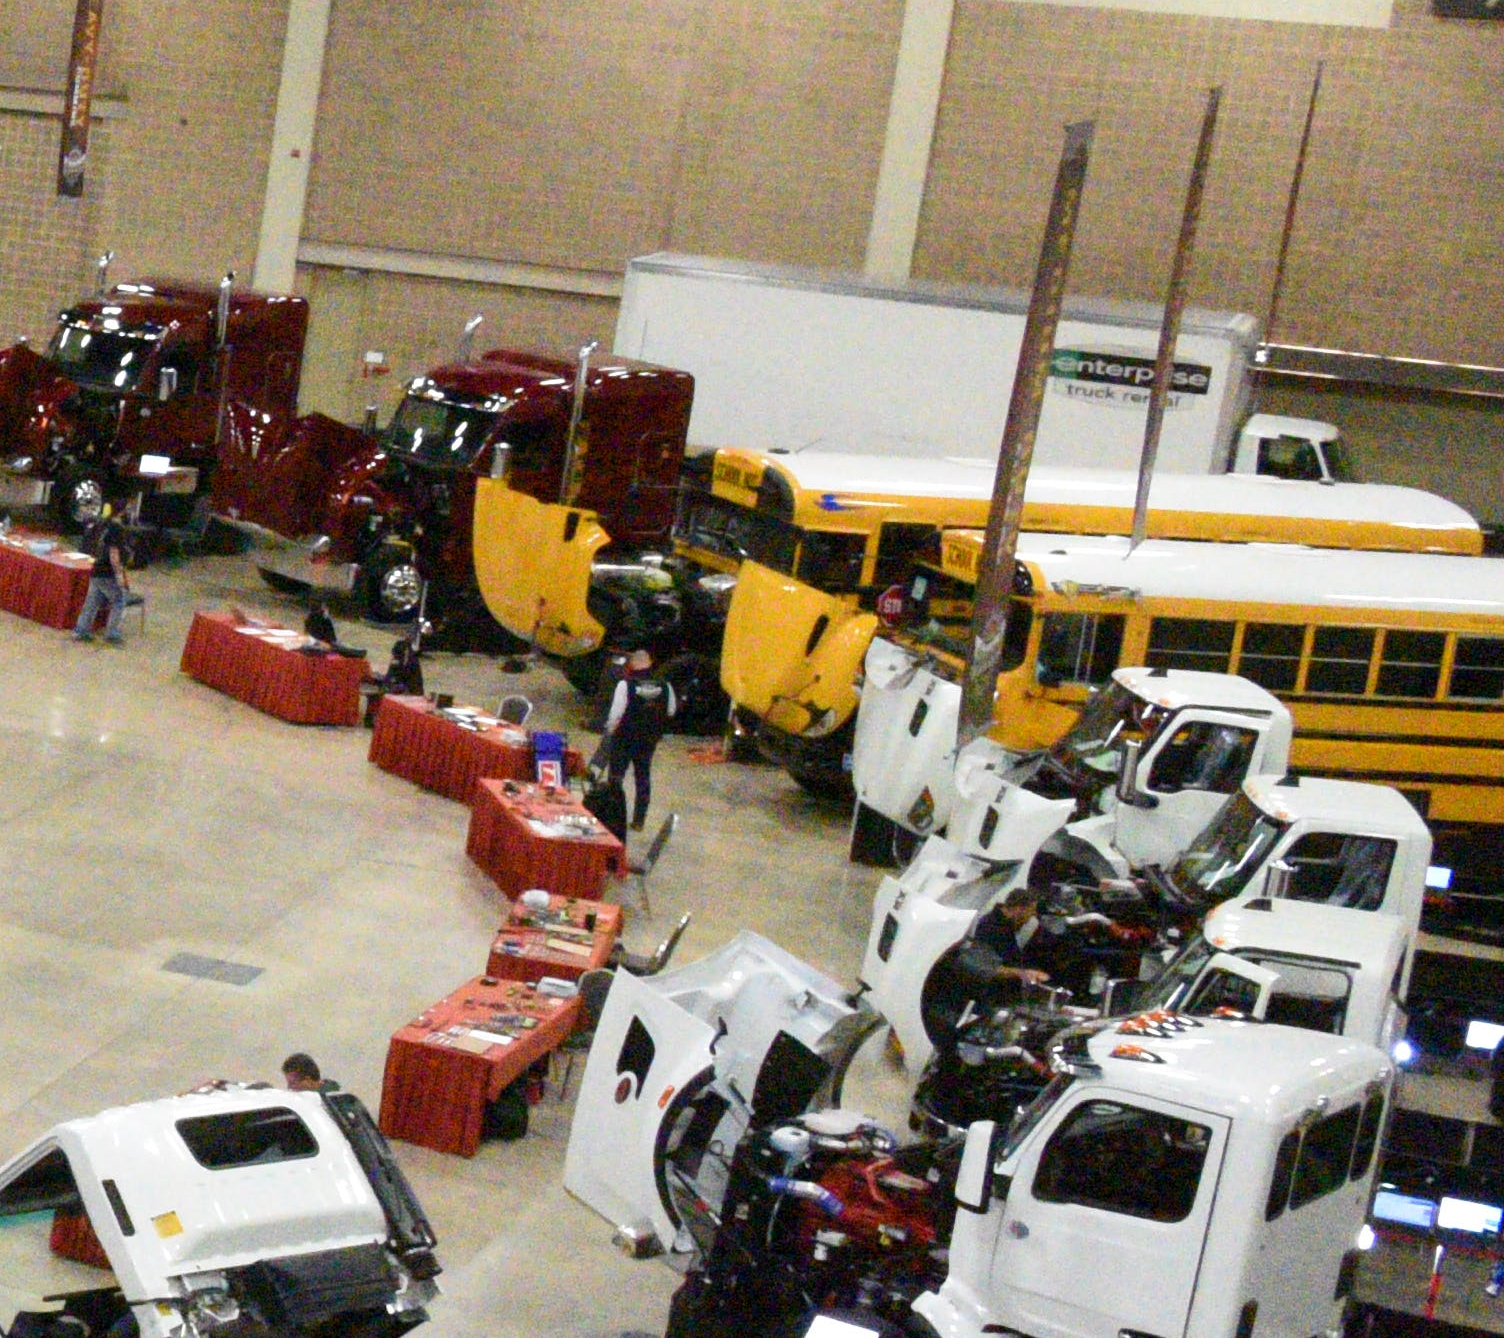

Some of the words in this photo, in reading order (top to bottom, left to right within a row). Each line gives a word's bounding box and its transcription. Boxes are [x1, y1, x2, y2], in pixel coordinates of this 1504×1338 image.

[1052, 357, 1208, 387] enterpse
[1066, 383, 1116, 401] truck
[1122, 391, 1181, 408] renal
